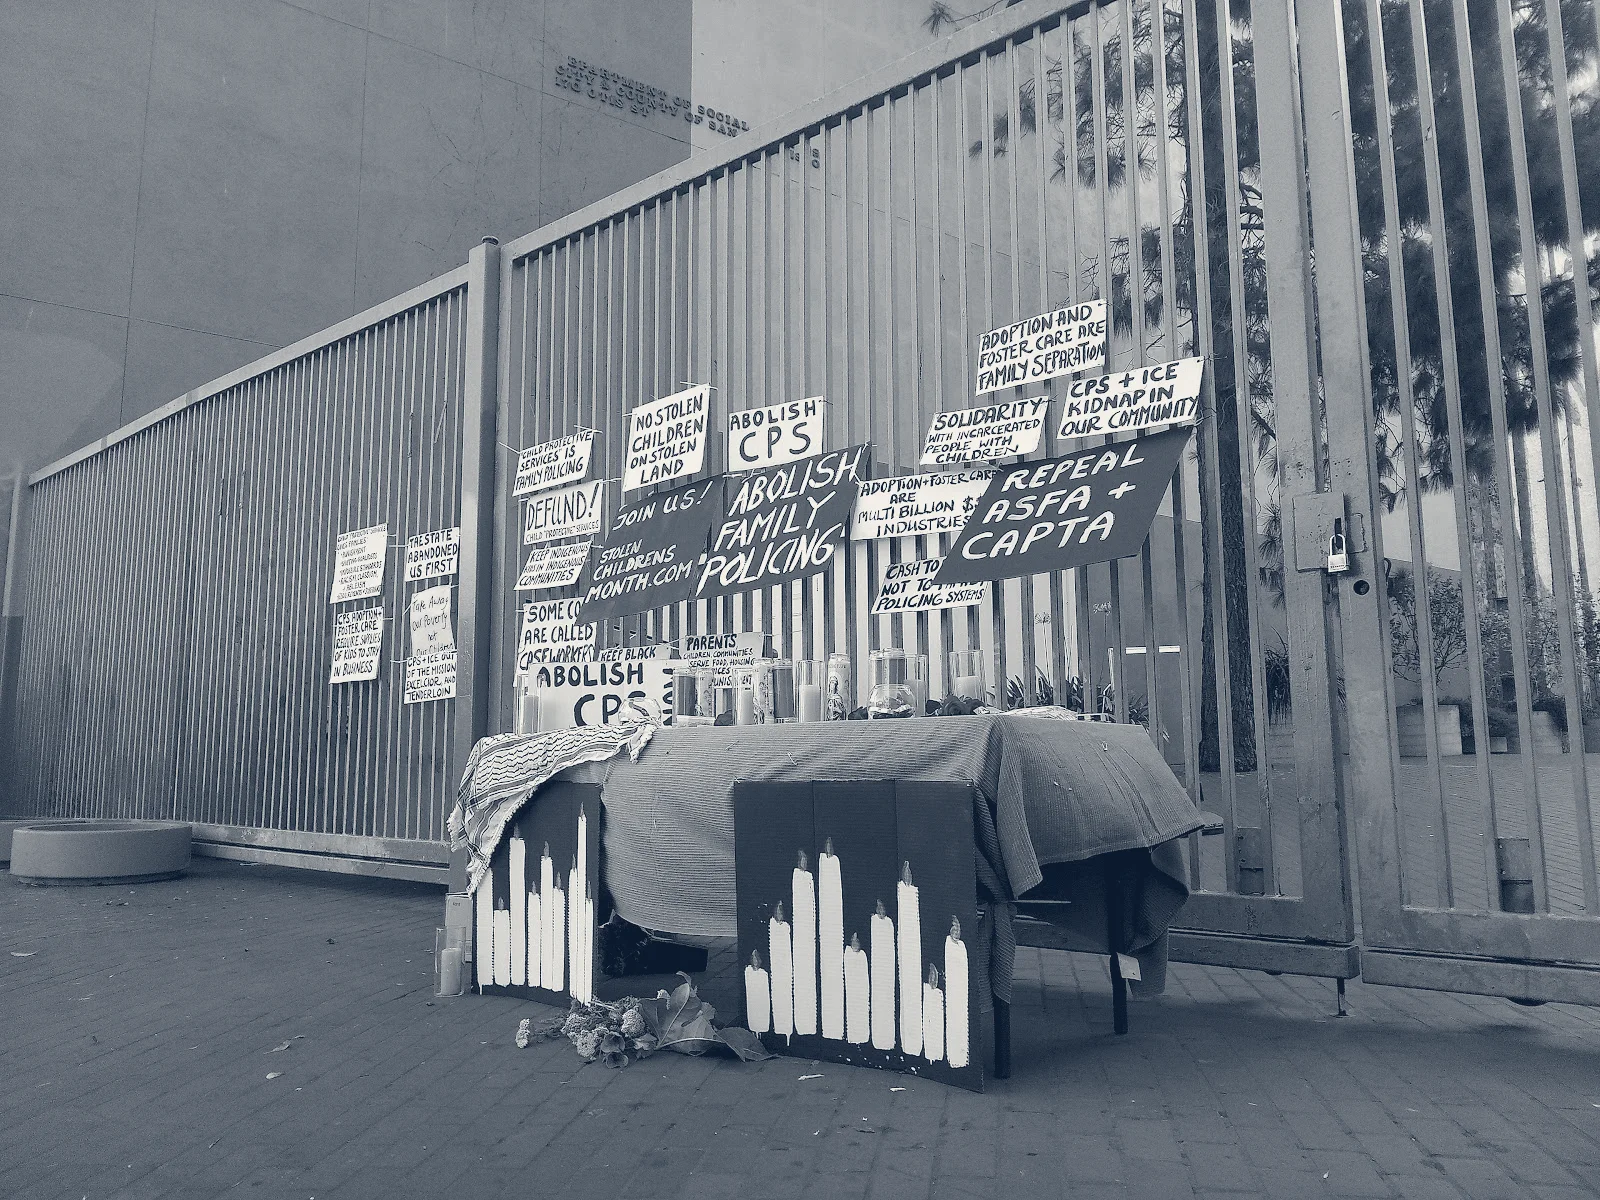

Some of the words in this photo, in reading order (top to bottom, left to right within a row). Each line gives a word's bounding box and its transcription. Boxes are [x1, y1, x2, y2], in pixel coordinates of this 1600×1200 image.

[616, 87, 679, 117] COUNTY
[684, 111, 704, 125] OF
[708, 120, 739, 138] SAN
[697, 104, 750, 133] SOCIAL
[981, 313, 1054, 352] ADOPTION
[1056, 305, 1093, 327] AND
[979, 340, 1034, 369] FOSTER
[1035, 328, 1073, 350] CARE
[1078, 320, 1106, 339] ARE
[978, 359, 1029, 391] FAMILY
[1031, 341, 1106, 377] SEPARATION
[1070, 375, 1110, 398] CPS
[1142, 362, 1179, 385] ICE
[636, 412, 652, 432] NO
[654, 393, 703, 426] STOLEN
[1068, 389, 1146, 417] KIDNAP
[1149, 384, 1175, 403] IN
[730, 399, 816, 431] ABOLISH
[934, 397, 1043, 431] SOLIDARITY
[1061, 415, 1103, 437] OUR
[1108, 395, 1200, 429] COMMUNITY
[544, 431, 592, 453] PROTECTIVE
[632, 414, 704, 453] CHILDREN
[739, 421, 811, 462] CPS
[928, 432, 953, 443] WITH
[956, 419, 1041, 440] INCARCERATED
[564, 445, 576, 460] IS
[630, 453, 648, 469] ON
[649, 437, 697, 464] STOLEN
[925, 440, 972, 454] PEOPLE
[979, 435, 1013, 448] WITH
[935, 444, 1019, 463] CHILDREN
[515, 468, 543, 491] FAMILY
[543, 456, 584, 482] POLICING
[640, 459, 684, 485] LAND
[1001, 443, 1145, 493] REPEAL
[728, 446, 862, 517] ABOLISH
[527, 482, 600, 531] DEFUND!
[612, 501, 656, 531] JOIN
[663, 480, 713, 514] US!
[889, 492, 917, 504] ARE
[982, 485, 1091, 524] ASFA
[714, 491, 836, 552] FAMILY
[858, 506, 895, 524] MULTI
[899, 499, 955, 518] BILLION
[424, 529, 453, 545] STATE
[525, 532, 543, 543] CHILD
[576, 519, 599, 532] SERVICES
[877, 515, 971, 537] INDUSTRIES
[961, 511, 1116, 560] CAPTA
[407, 543, 458, 564] ABANDONED
[530, 546, 550, 563] KEEP
[593, 544, 677, 581] CHILDRENS
[600, 539, 643, 564] STOLEN
[695, 523, 842, 597] POLICING
[410, 564, 422, 578] US
[426, 557, 454, 576] FIRST
[519, 568, 575, 587] COMMUNITIES
[886, 563, 920, 580] CASH
[922, 559, 940, 574] TO
[585, 559, 693, 604] MONTH.COM
[880, 580, 911, 597] NOT
[917, 578, 933, 592] TO
[527, 601, 564, 623] SOME
[876, 593, 943, 611] POLICING
[946, 588, 984, 603] SYSTEMS
[338, 623, 360, 636] FOSTER
[361, 620, 378, 632] CARE
[524, 627, 547, 645] ARE
[551, 624, 594, 643] CALLED
[335, 650, 343, 661] OF
[344, 649, 357, 660] KIDS
[359, 648, 366, 658] TO
[441, 652, 455, 661] OUT
[601, 649, 623, 661] KEEP
[625, 647, 657, 661] BLACK
[713, 648, 753, 657] COMMUNITIES
[334, 666, 342, 677] IN
[343, 660, 373, 676] BUSINESS
[407, 669, 415, 678] OF
[417, 666, 430, 677] THE
[431, 662, 457, 675] MISSION
[444, 676, 456, 684] AND
[537, 662, 644, 688] ABOLISH
[406, 686, 451, 702] TENDERLOIN
